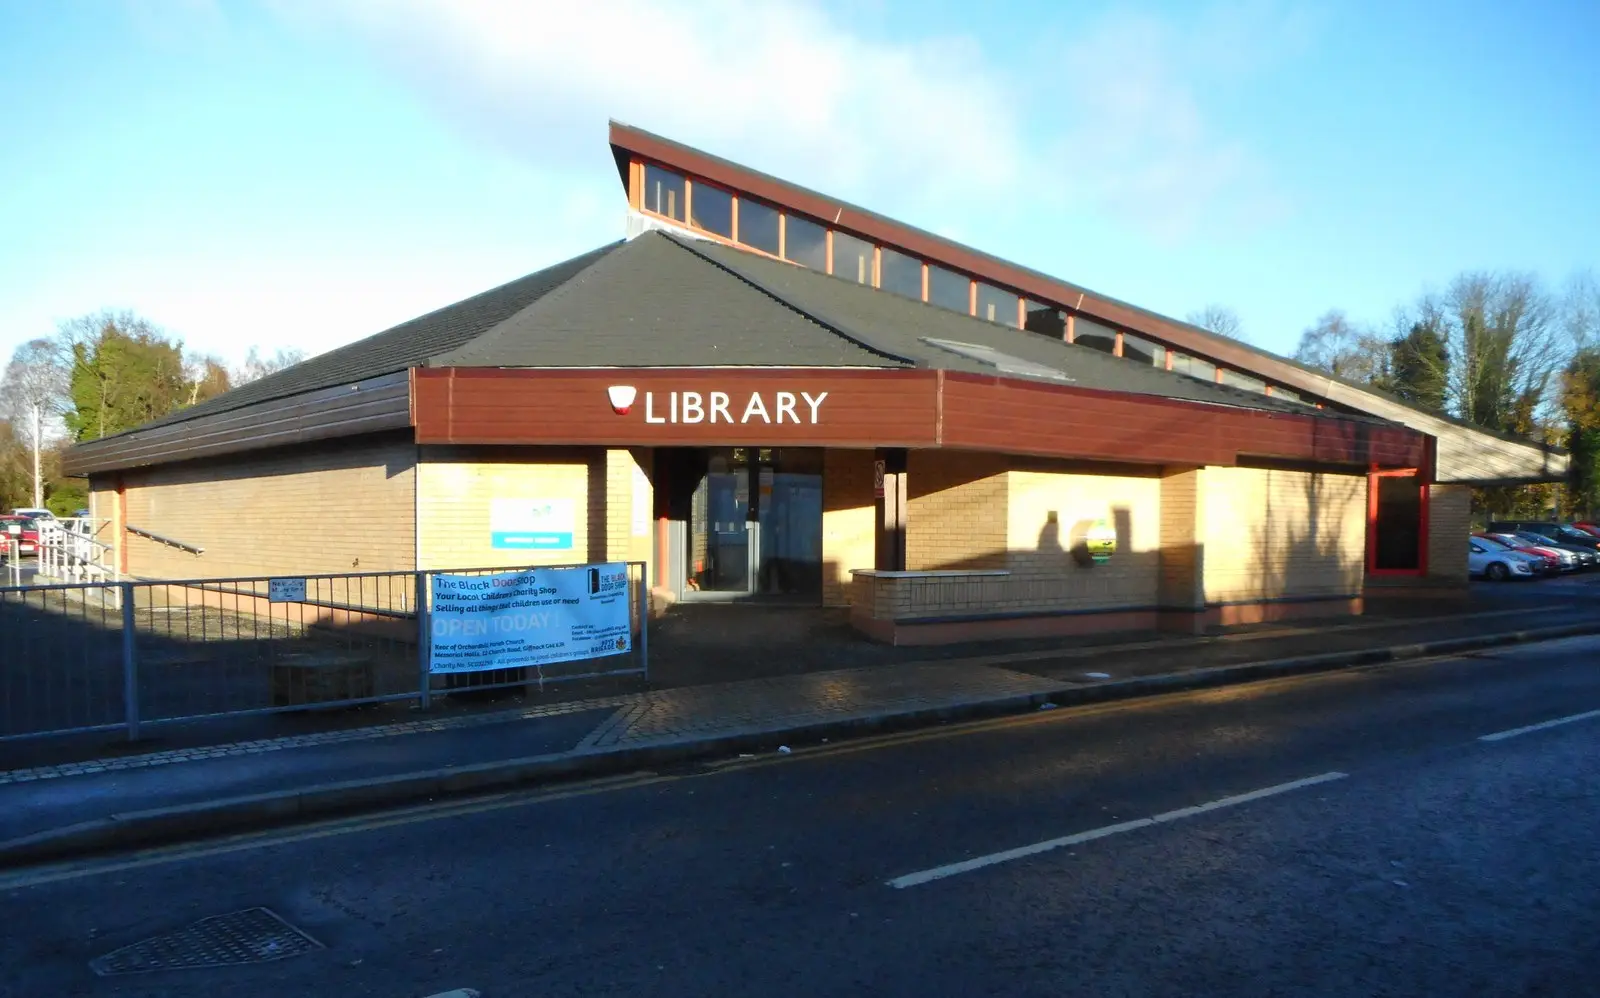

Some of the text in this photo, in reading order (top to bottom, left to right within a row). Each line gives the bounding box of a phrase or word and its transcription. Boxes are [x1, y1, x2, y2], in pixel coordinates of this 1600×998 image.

[645, 391, 829, 424] LIBRARY
[436, 578, 456, 589] The
[458, 580, 490, 590] Black
[456, 592, 480, 600] Local
[513, 588, 538, 596] Charity
[539, 587, 557, 595] Shop
[436, 604, 464, 614] Selling
[466, 604, 478, 612] all
[478, 604, 498, 613] things
[512, 600, 540, 608] children
[432, 617, 487, 637] OPEN
[492, 611, 552, 633] TODAY
